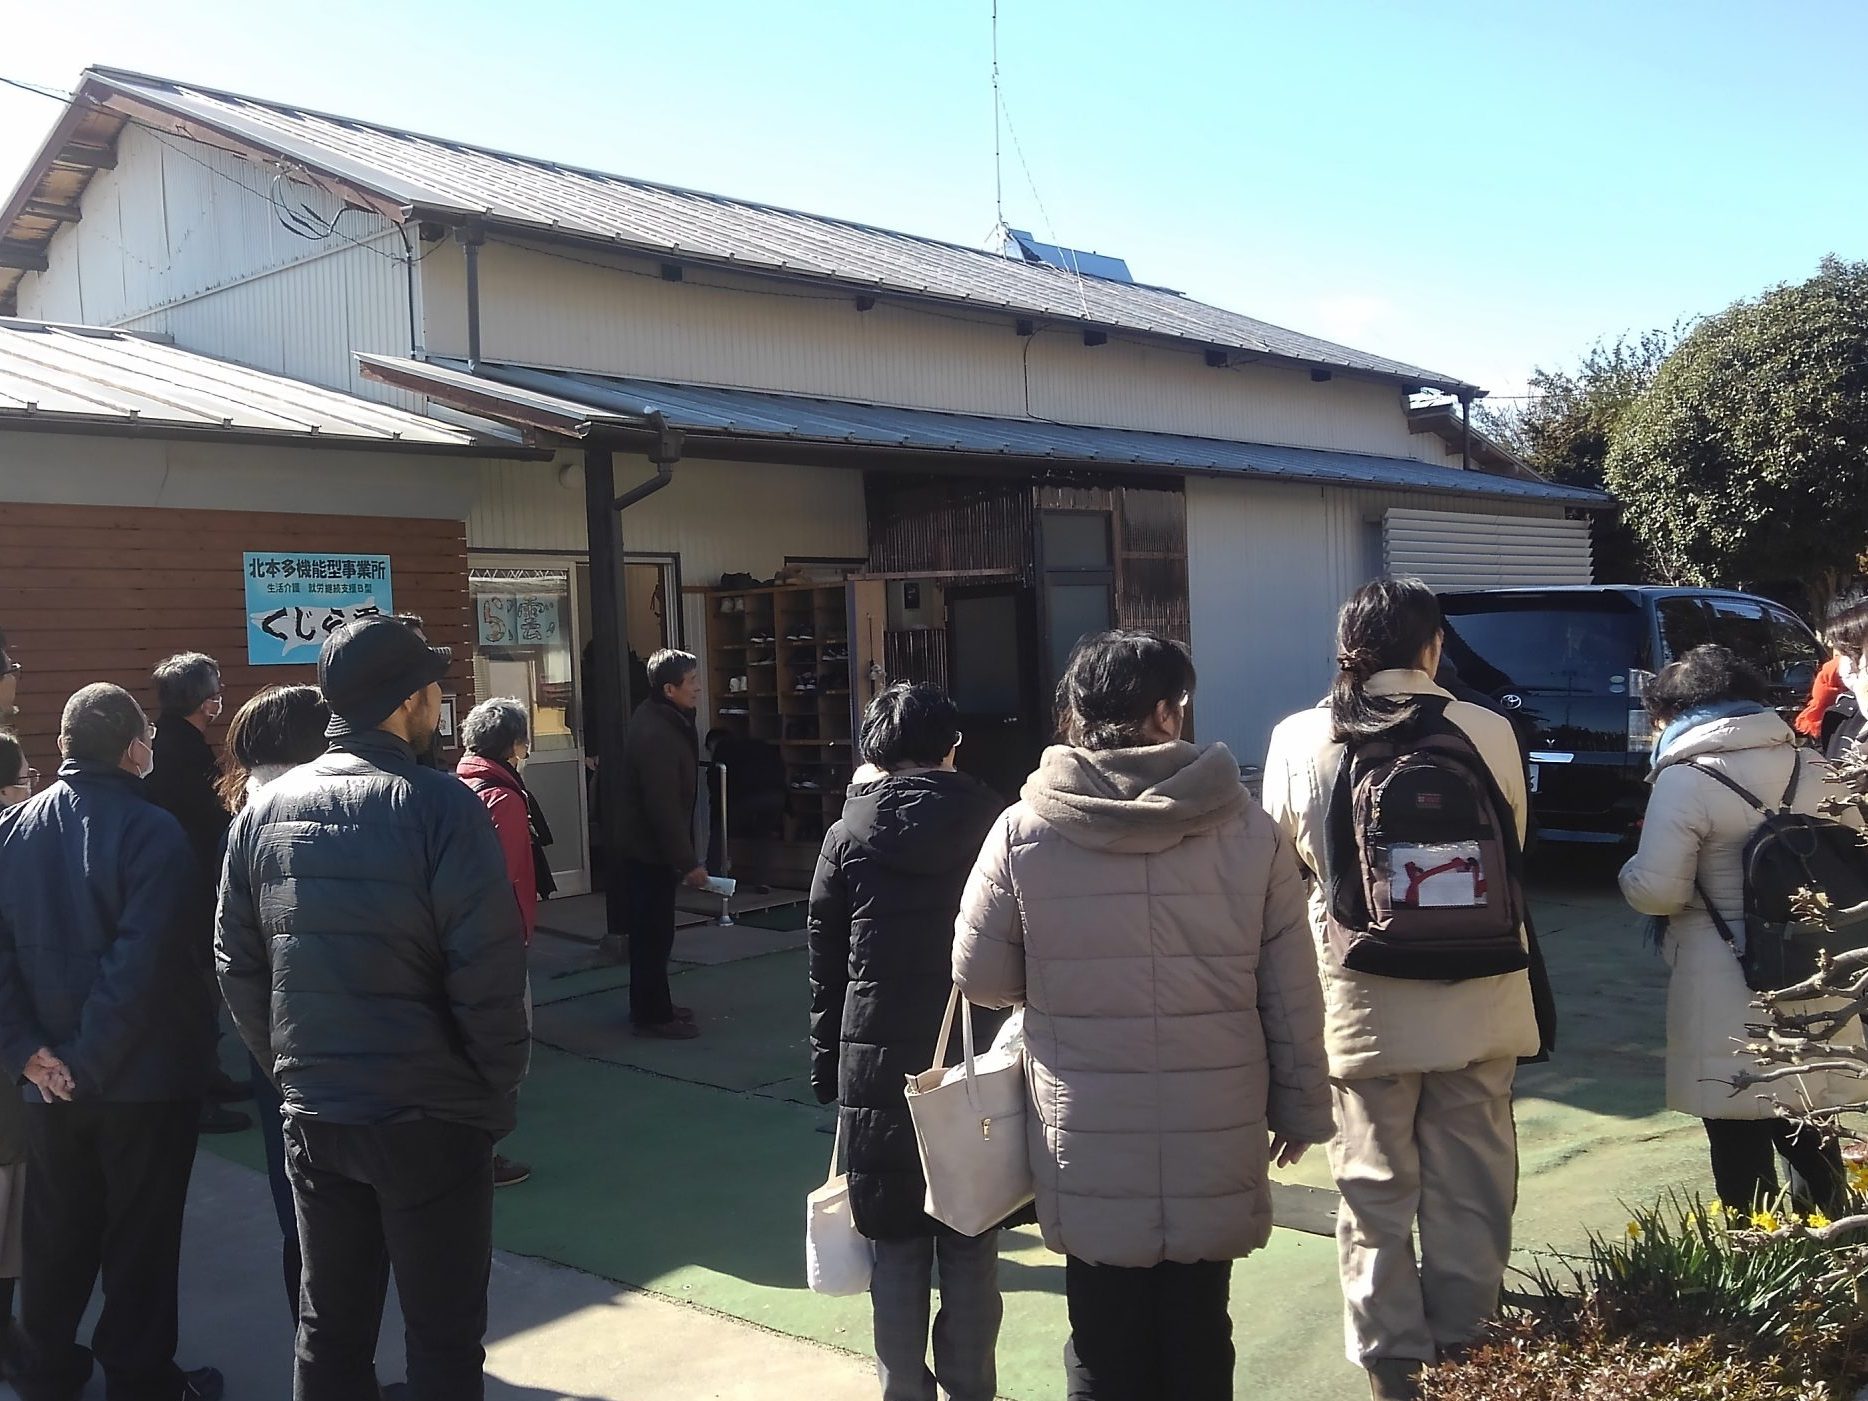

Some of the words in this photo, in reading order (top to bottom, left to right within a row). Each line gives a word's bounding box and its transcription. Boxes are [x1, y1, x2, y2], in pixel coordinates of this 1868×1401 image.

[249, 558, 386, 580] 北本多機能型事業所
